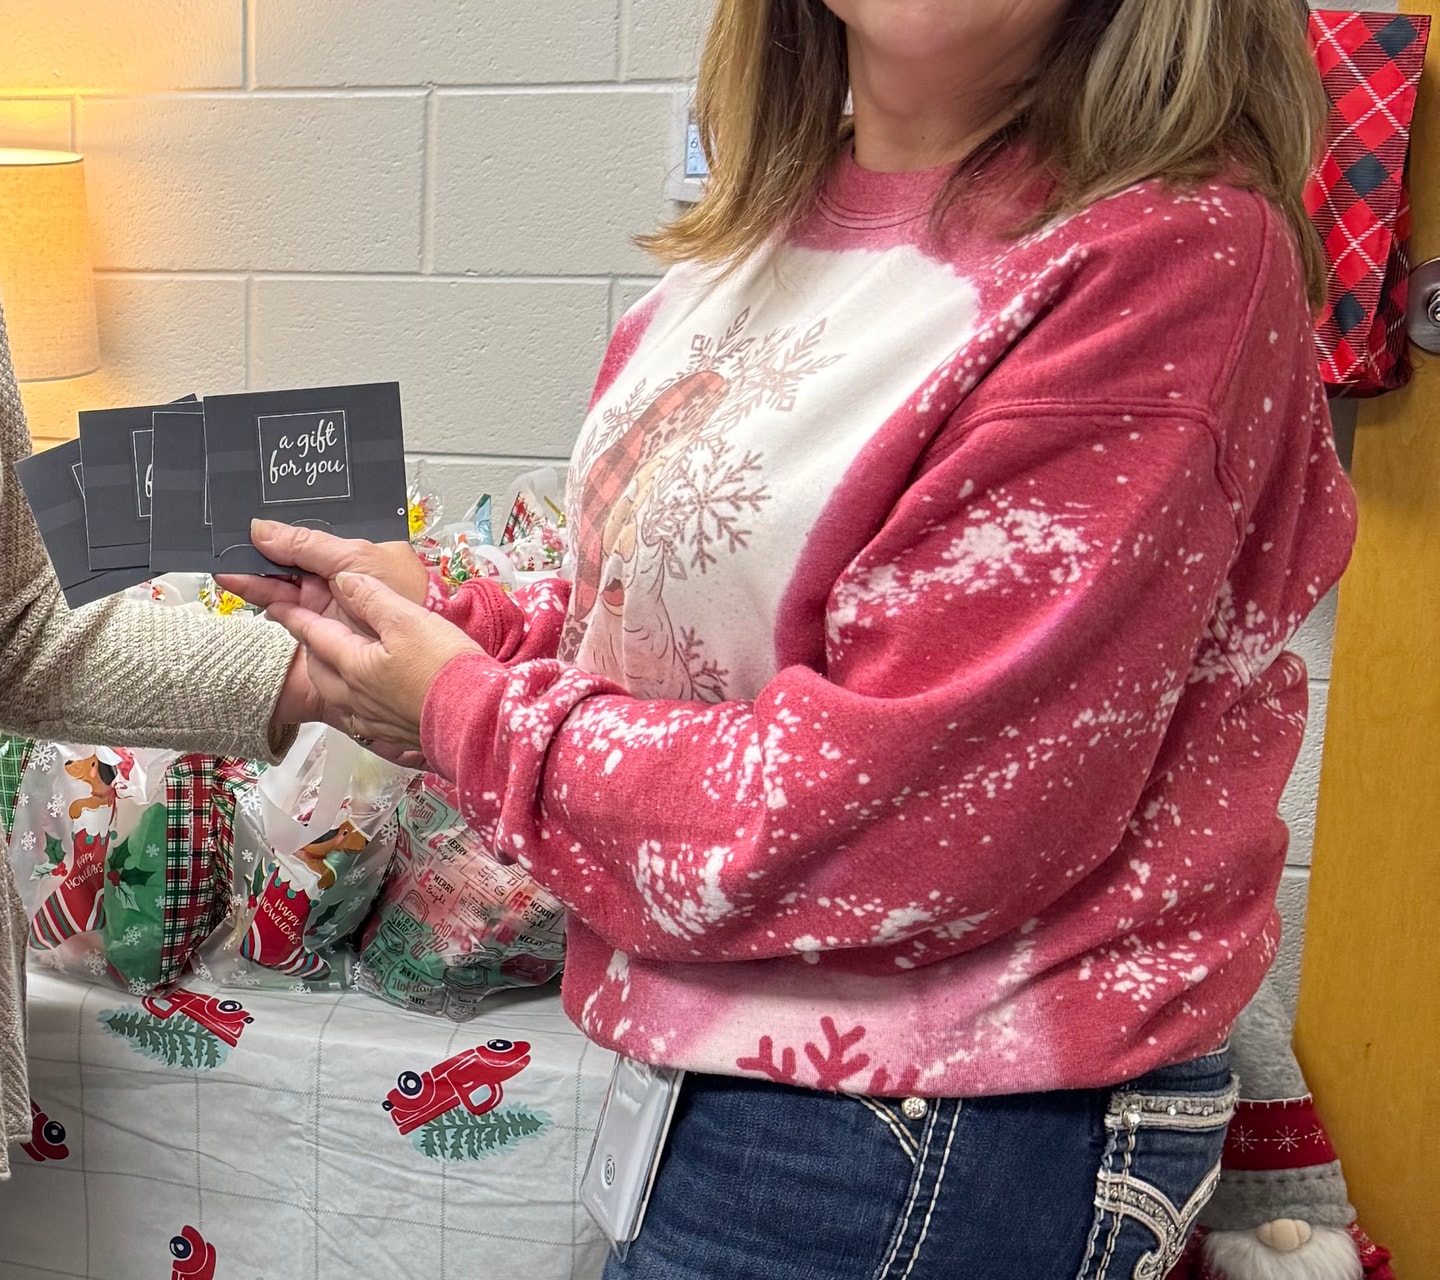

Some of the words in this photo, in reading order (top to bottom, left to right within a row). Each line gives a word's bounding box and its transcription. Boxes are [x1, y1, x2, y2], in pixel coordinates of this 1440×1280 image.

[279, 434, 295, 450] a
[296, 418, 338, 458] gift
[269, 449, 303, 485] for
[305, 458, 346, 487] you
[433, 874, 456, 895] MERRY
[529, 900, 556, 920] MERRY
